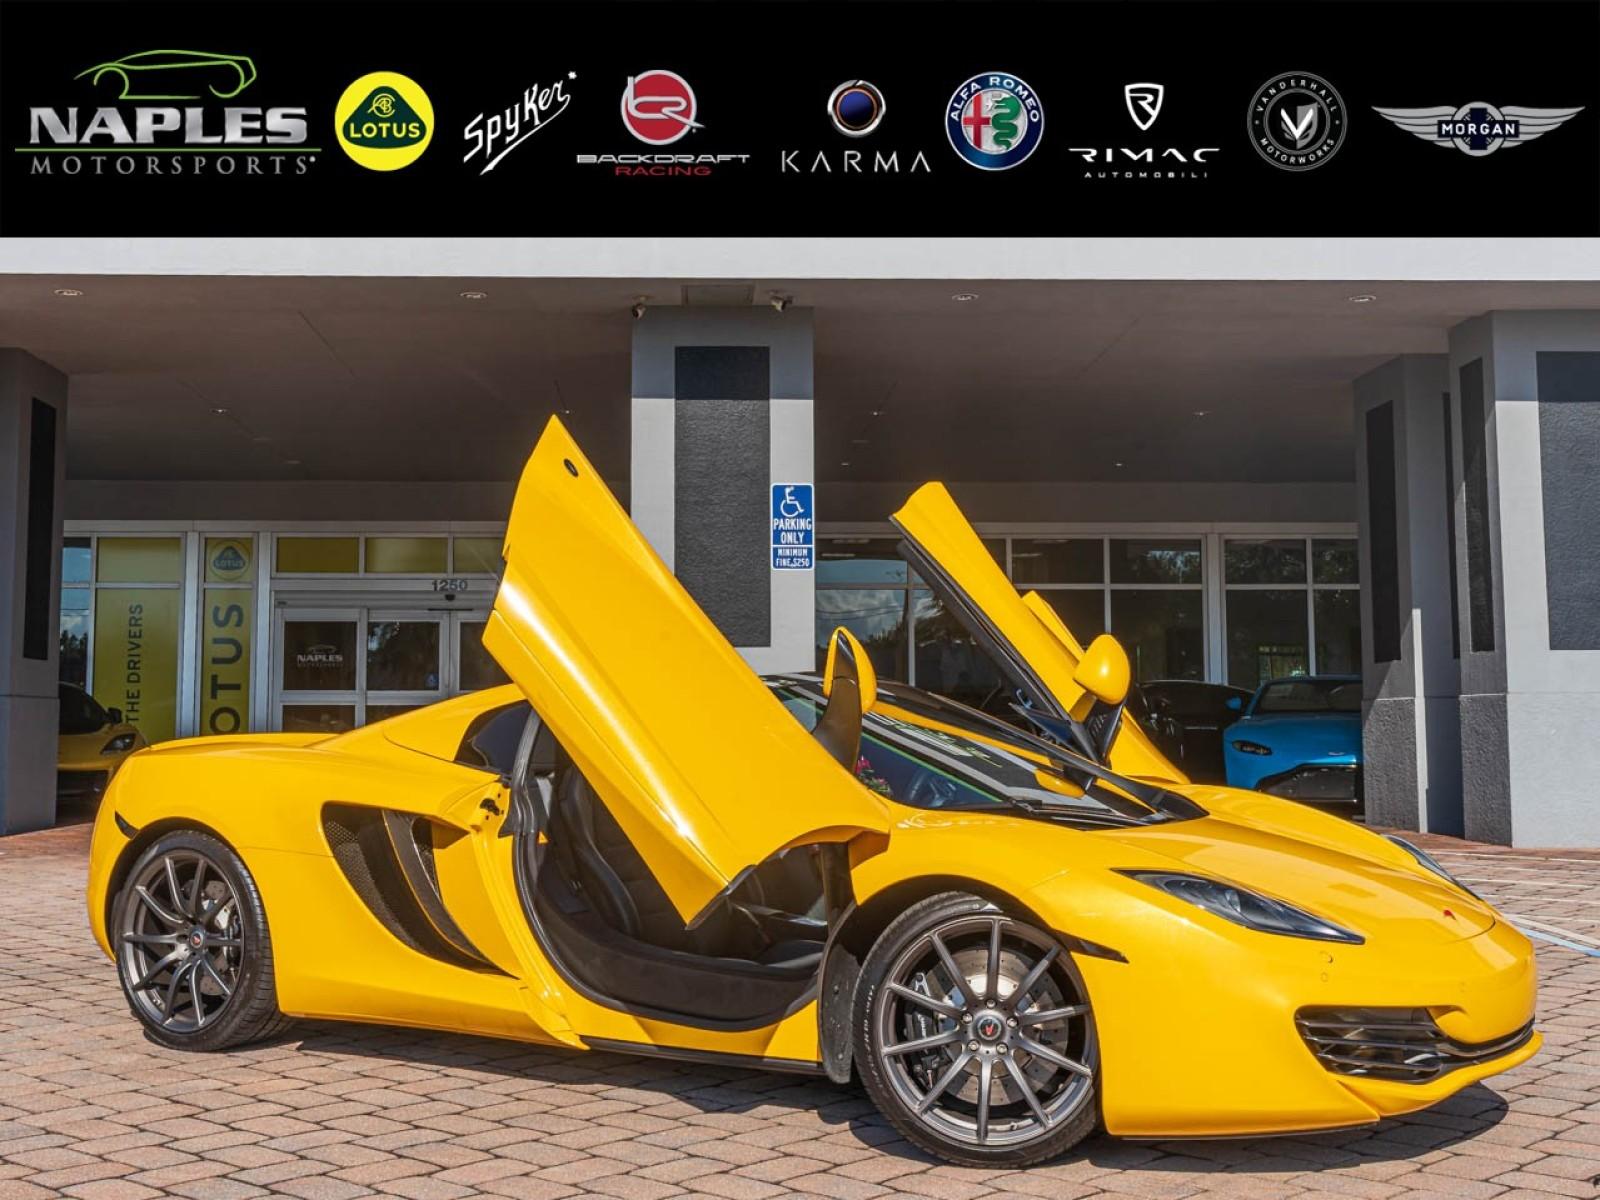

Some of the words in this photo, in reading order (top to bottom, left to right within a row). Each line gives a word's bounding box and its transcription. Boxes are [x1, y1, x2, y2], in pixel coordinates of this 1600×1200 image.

[773, 518, 812, 531] PARKING
[780, 531, 805, 544] ONLY
[777, 548, 808, 557] MINIMUM
[776, 558, 791, 567] FINE
[432, 579, 468, 593] 1250
[126, 603, 143, 684] DRIVERS
[296, 653, 344, 663] NAPLES
[209, 604, 245, 734] OTUS
[125, 688, 142, 724] THE
